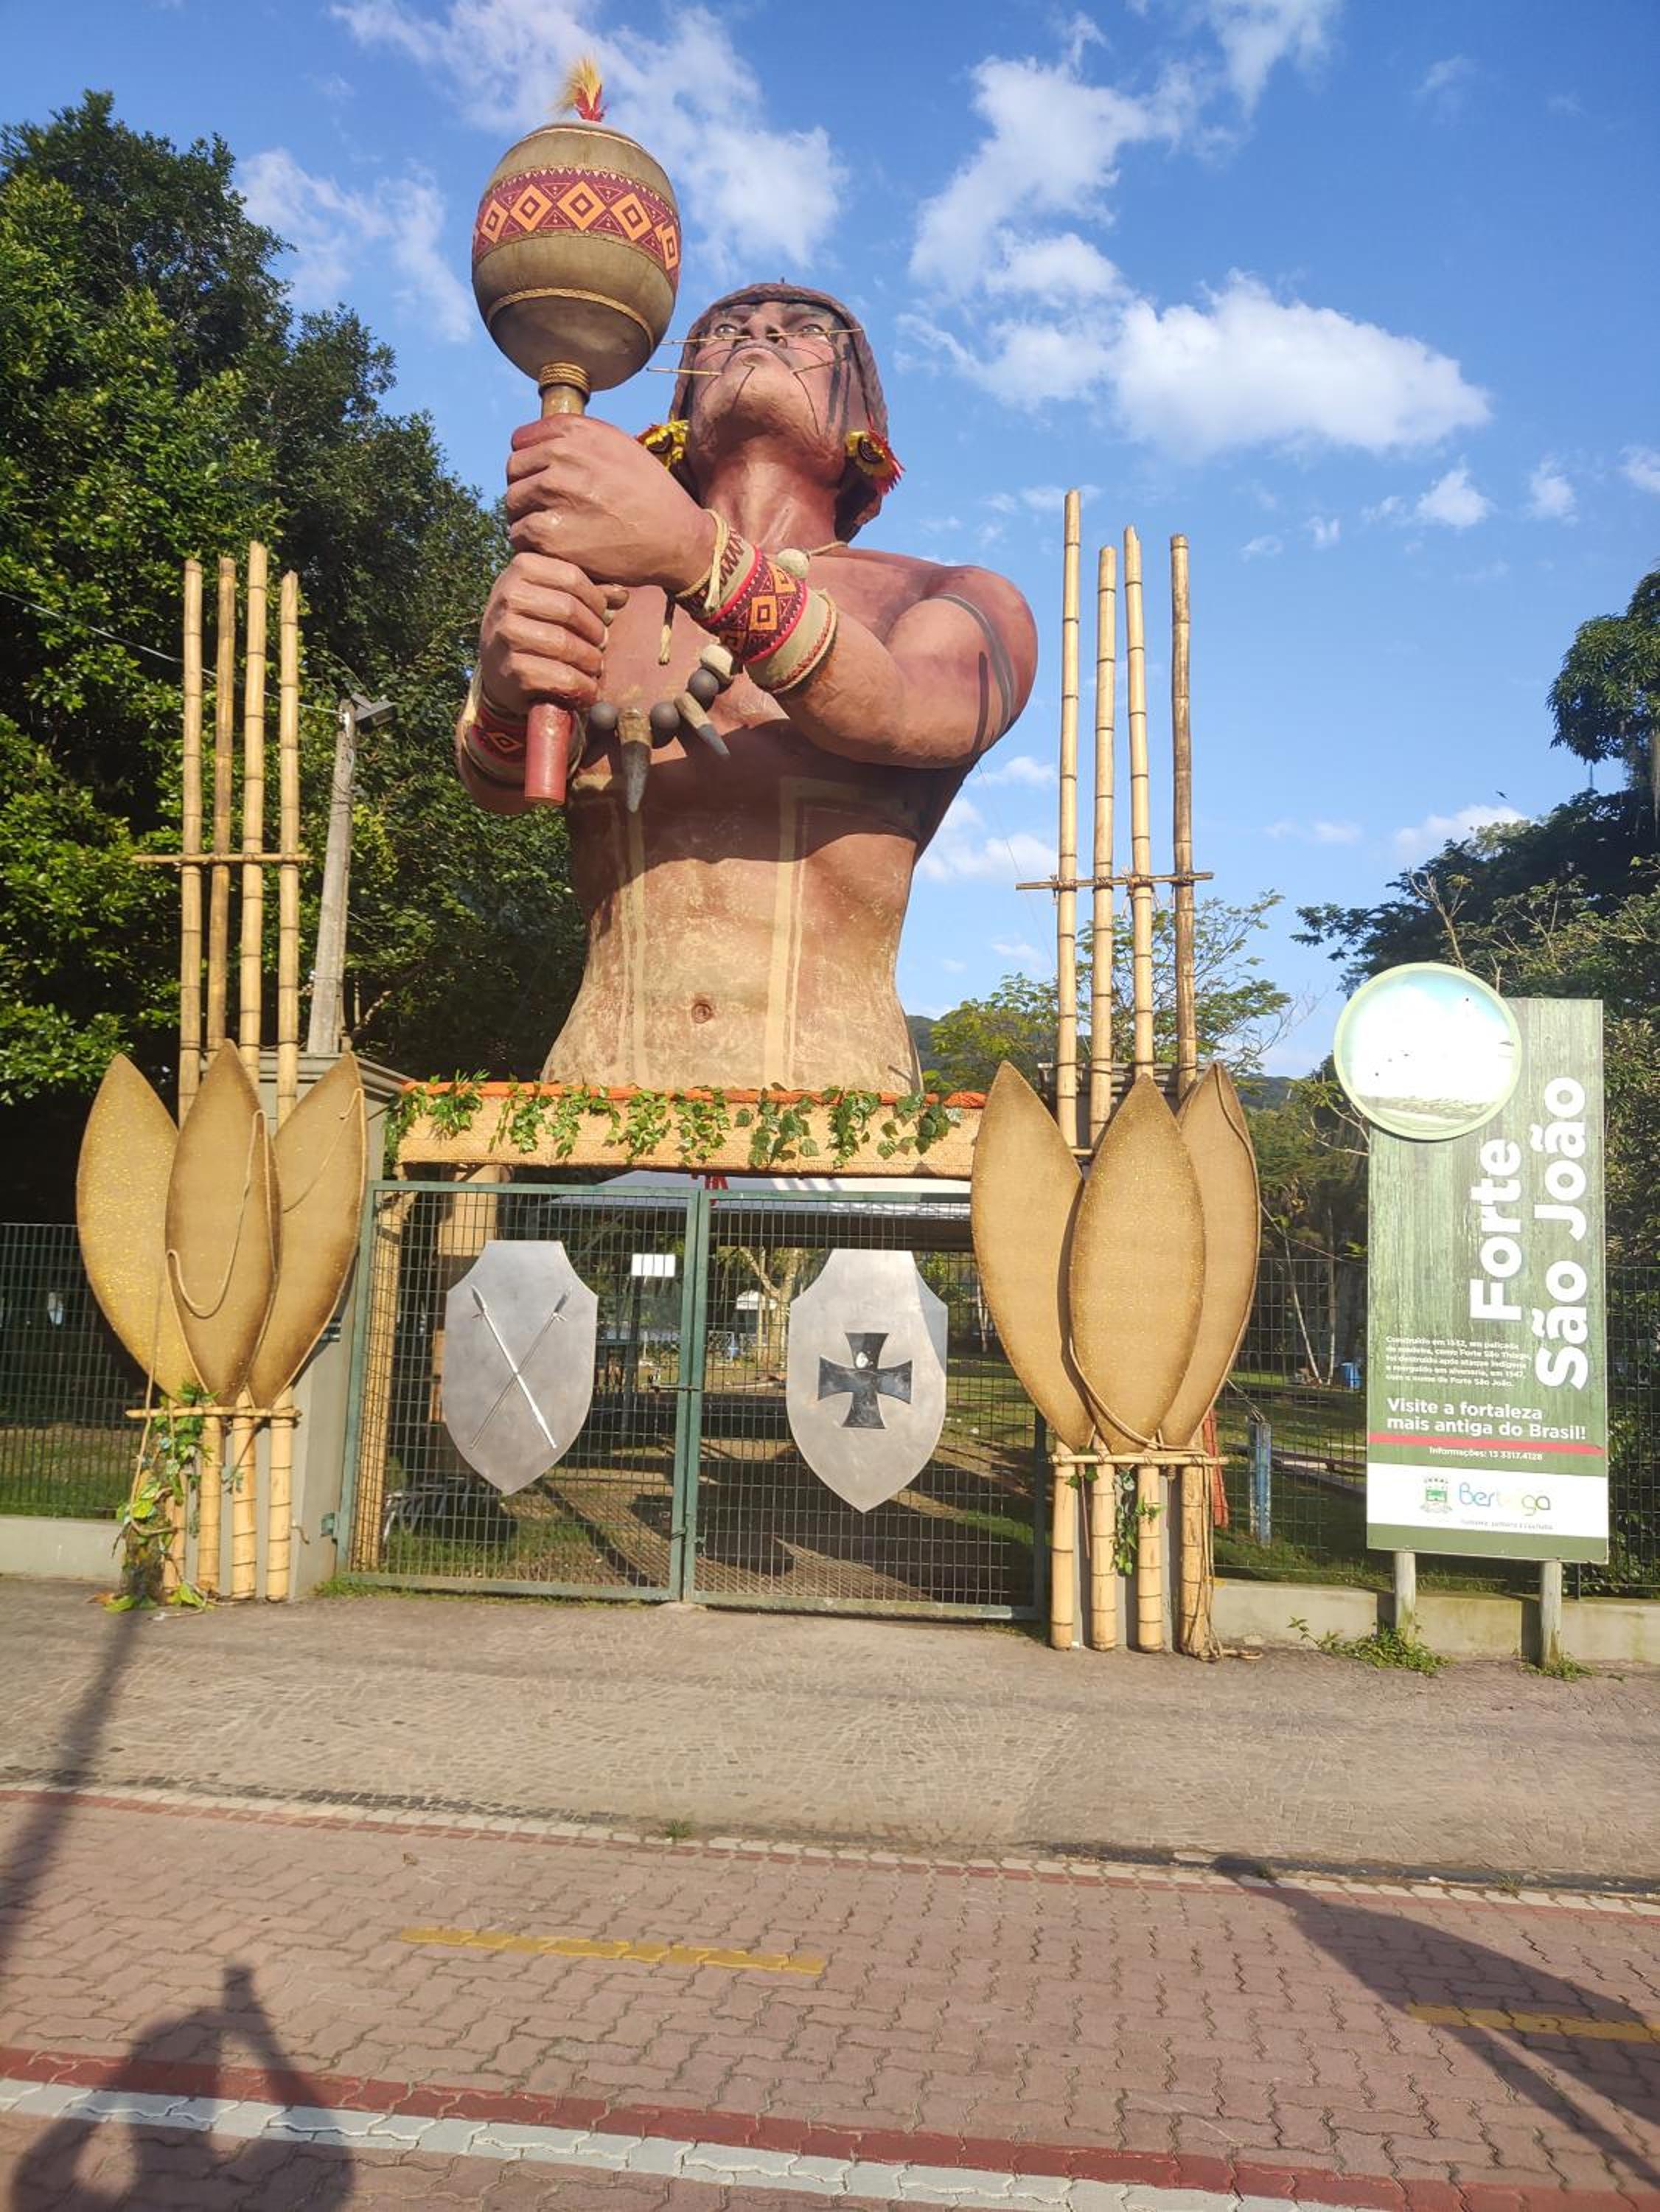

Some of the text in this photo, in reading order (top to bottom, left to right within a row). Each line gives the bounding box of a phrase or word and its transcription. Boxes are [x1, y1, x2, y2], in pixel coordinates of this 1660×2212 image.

[1469, 1138, 1523, 1321] Forte
[1530, 1077, 1588, 1391] São João
[1386, 1397, 1543, 1421] Visite a fortaleza
[1387, 1416, 1587, 1440] mais antiga do Brasil!
[1429, 1446, 1488, 1460] Informações:
[1488, 1450, 1499, 1458] 13
